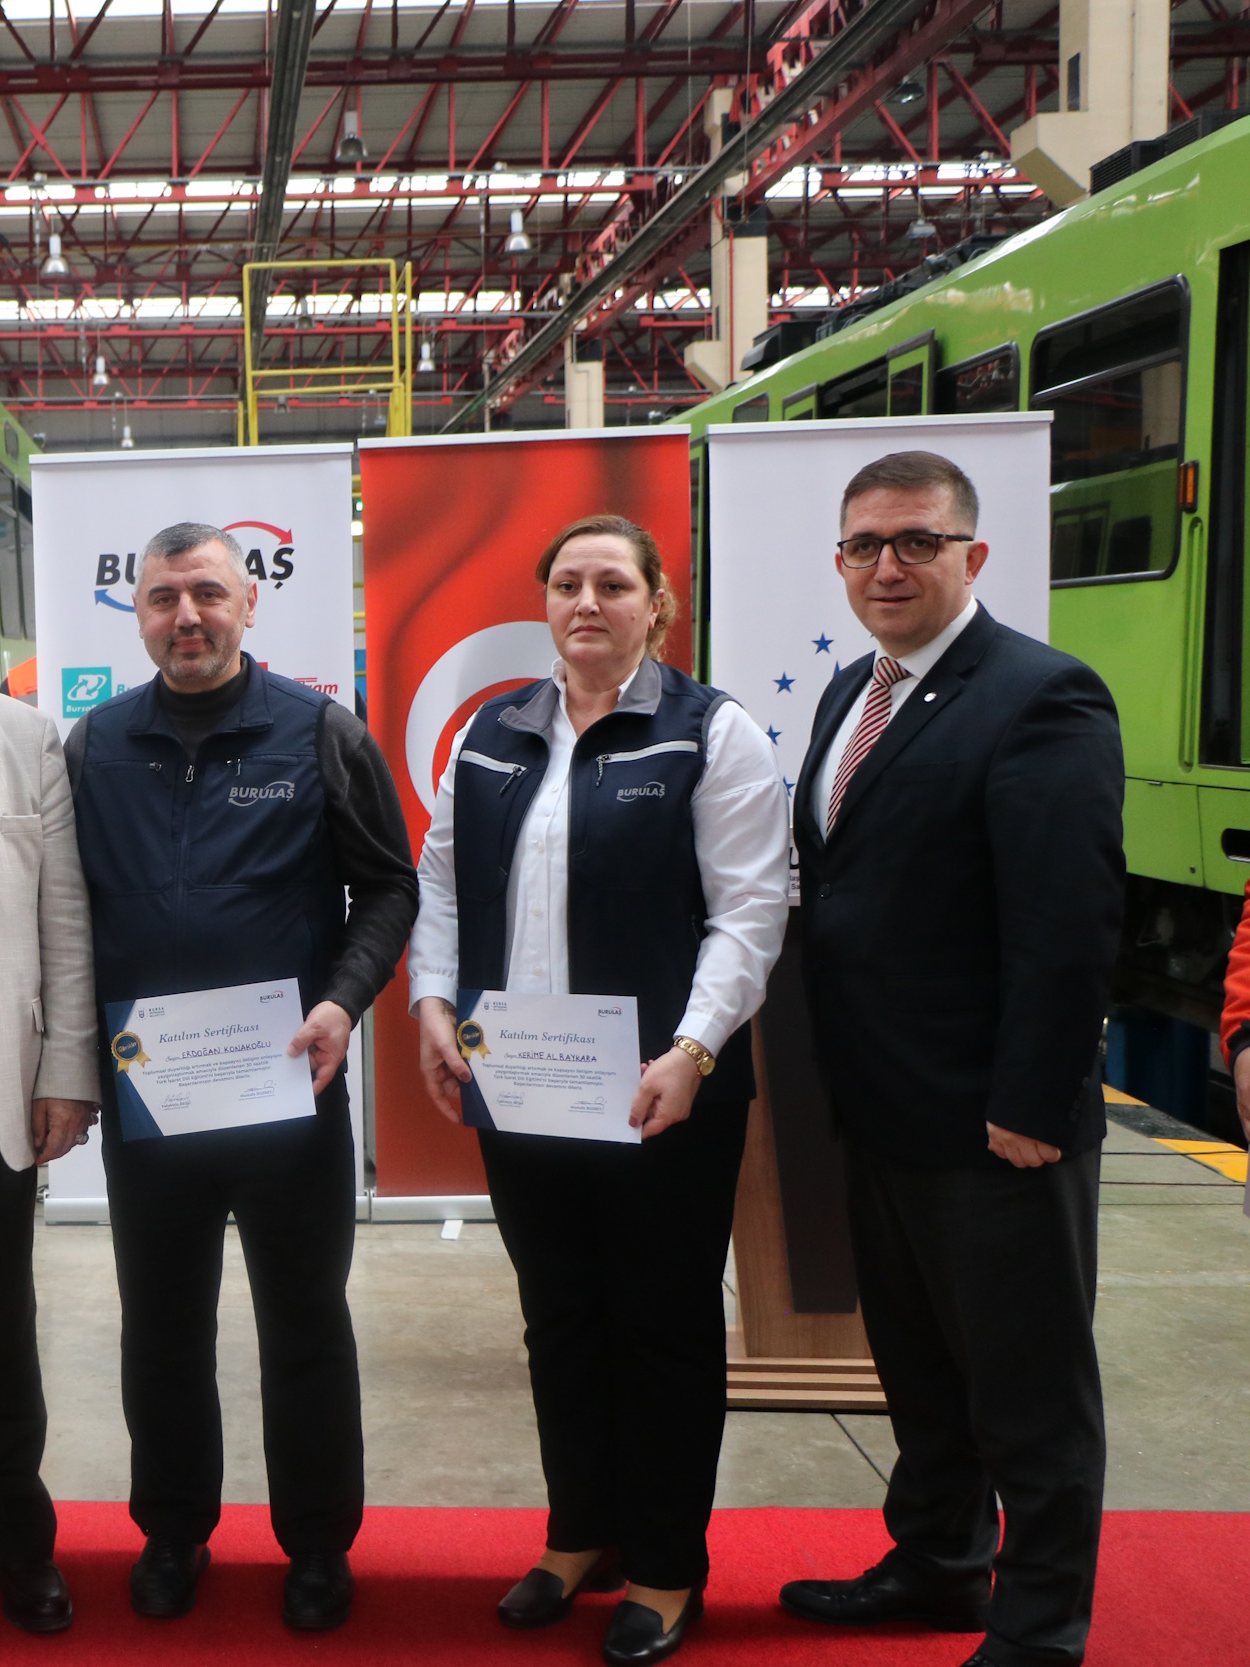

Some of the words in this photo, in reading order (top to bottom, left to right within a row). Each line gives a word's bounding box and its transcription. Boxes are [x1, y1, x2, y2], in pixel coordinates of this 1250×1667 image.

[229, 785, 294, 802] BURULAŞ
[617, 786, 666, 799] BURULAŞ
[159, 1032, 200, 1043] Katılım
[204, 1024, 259, 1037] Sertifikası
[500, 1030, 538, 1040] Katılım
[542, 1032, 595, 1045] Sertifikası
